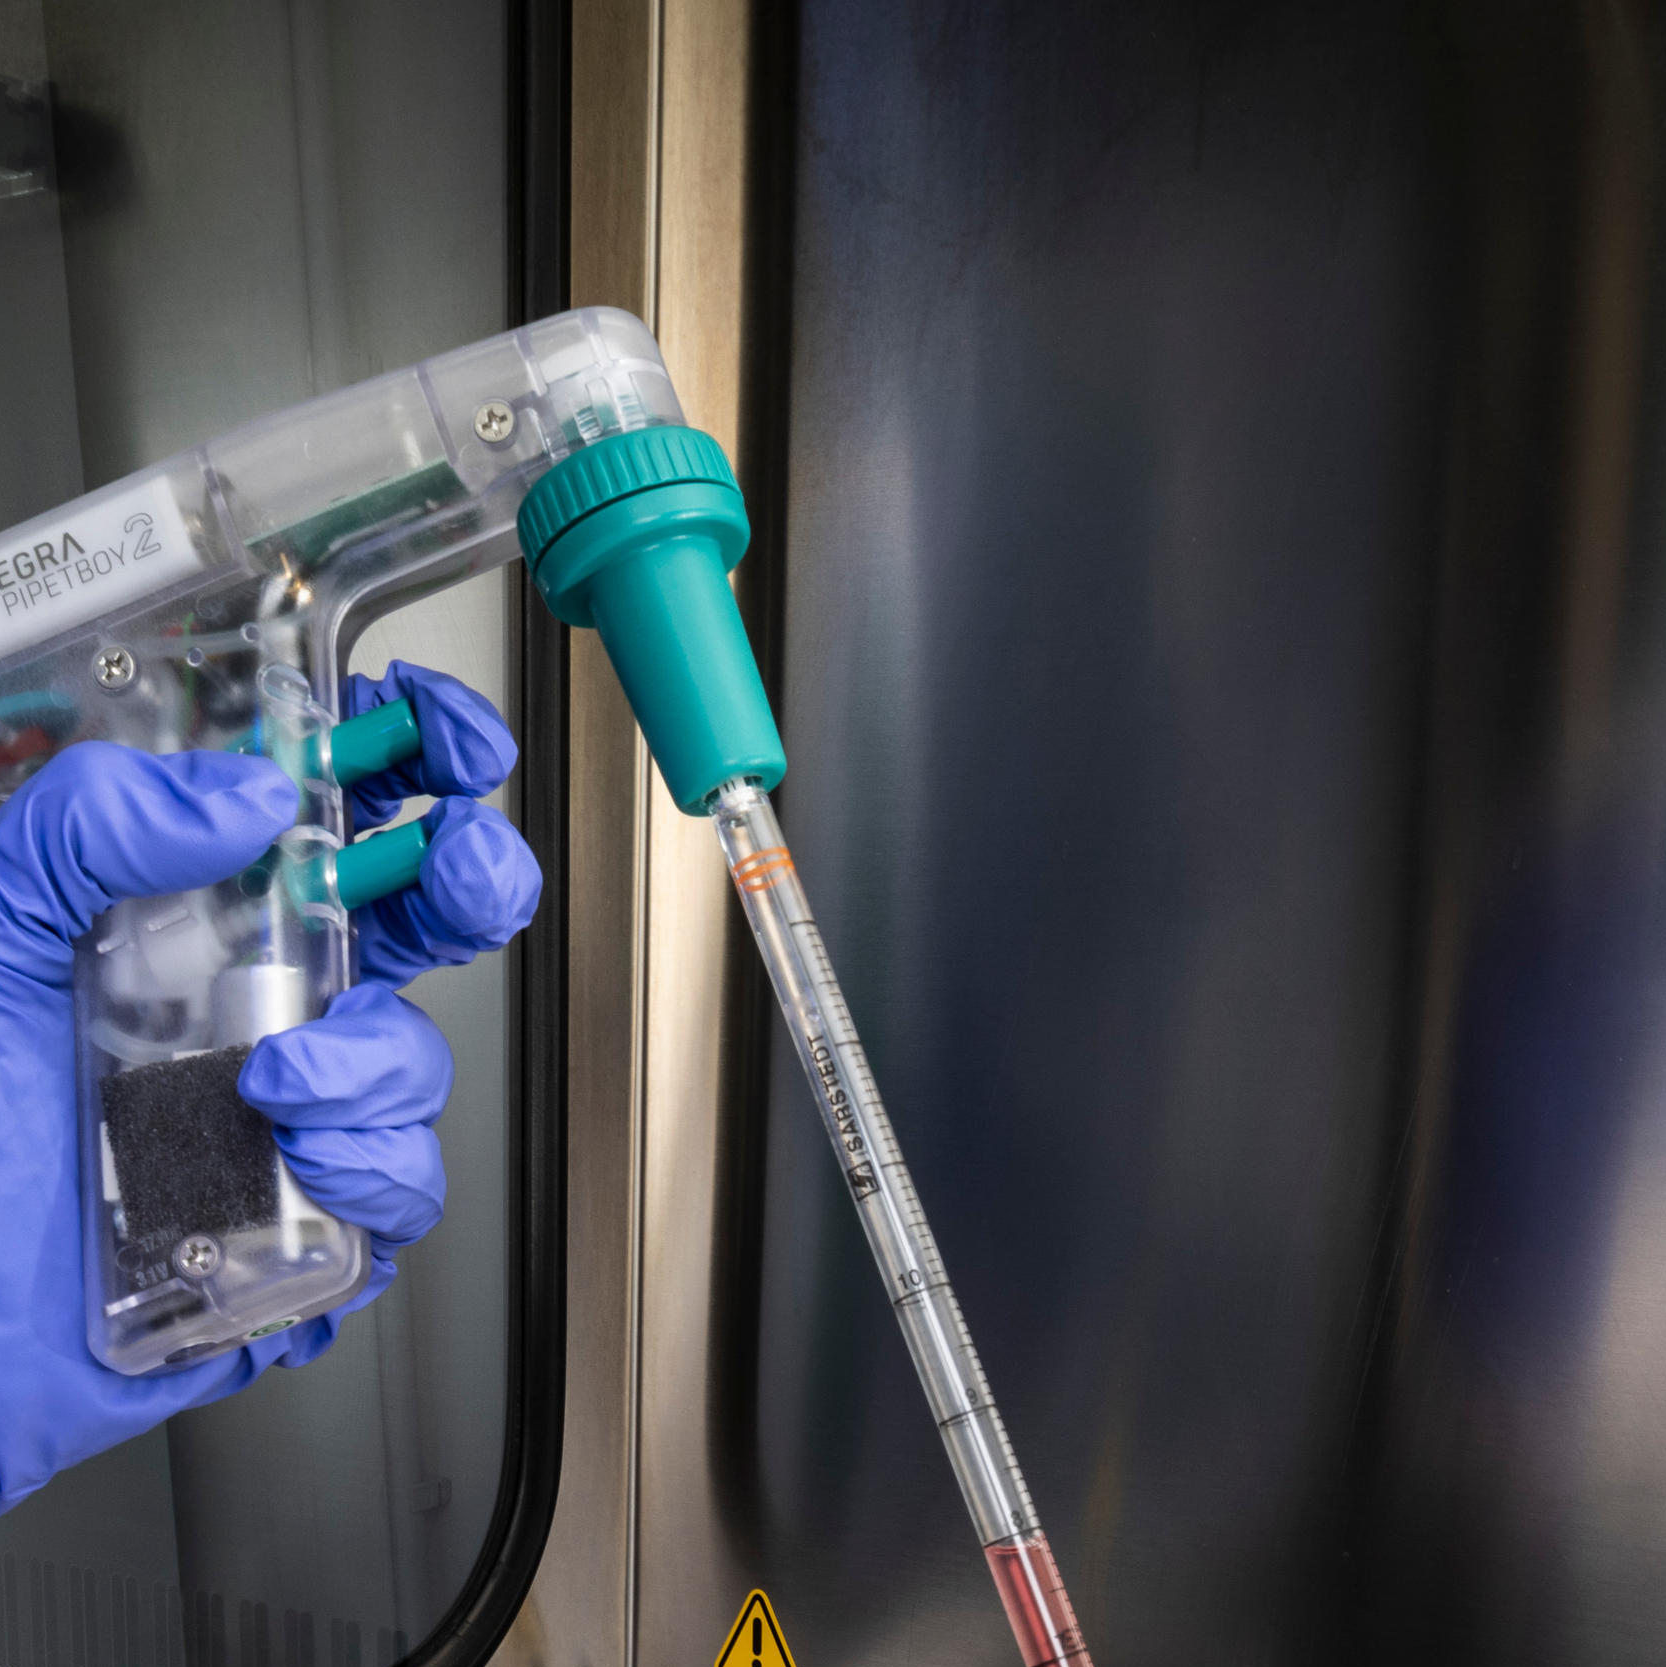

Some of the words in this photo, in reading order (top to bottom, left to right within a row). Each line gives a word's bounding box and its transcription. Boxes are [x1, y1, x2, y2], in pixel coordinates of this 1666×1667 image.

[2, 542, 126, 616] PIPETBOY
[124, 513, 162, 560] 2
[807, 1034, 863, 1152] SARSTEDT
[898, 1269, 922, 1290] 10
